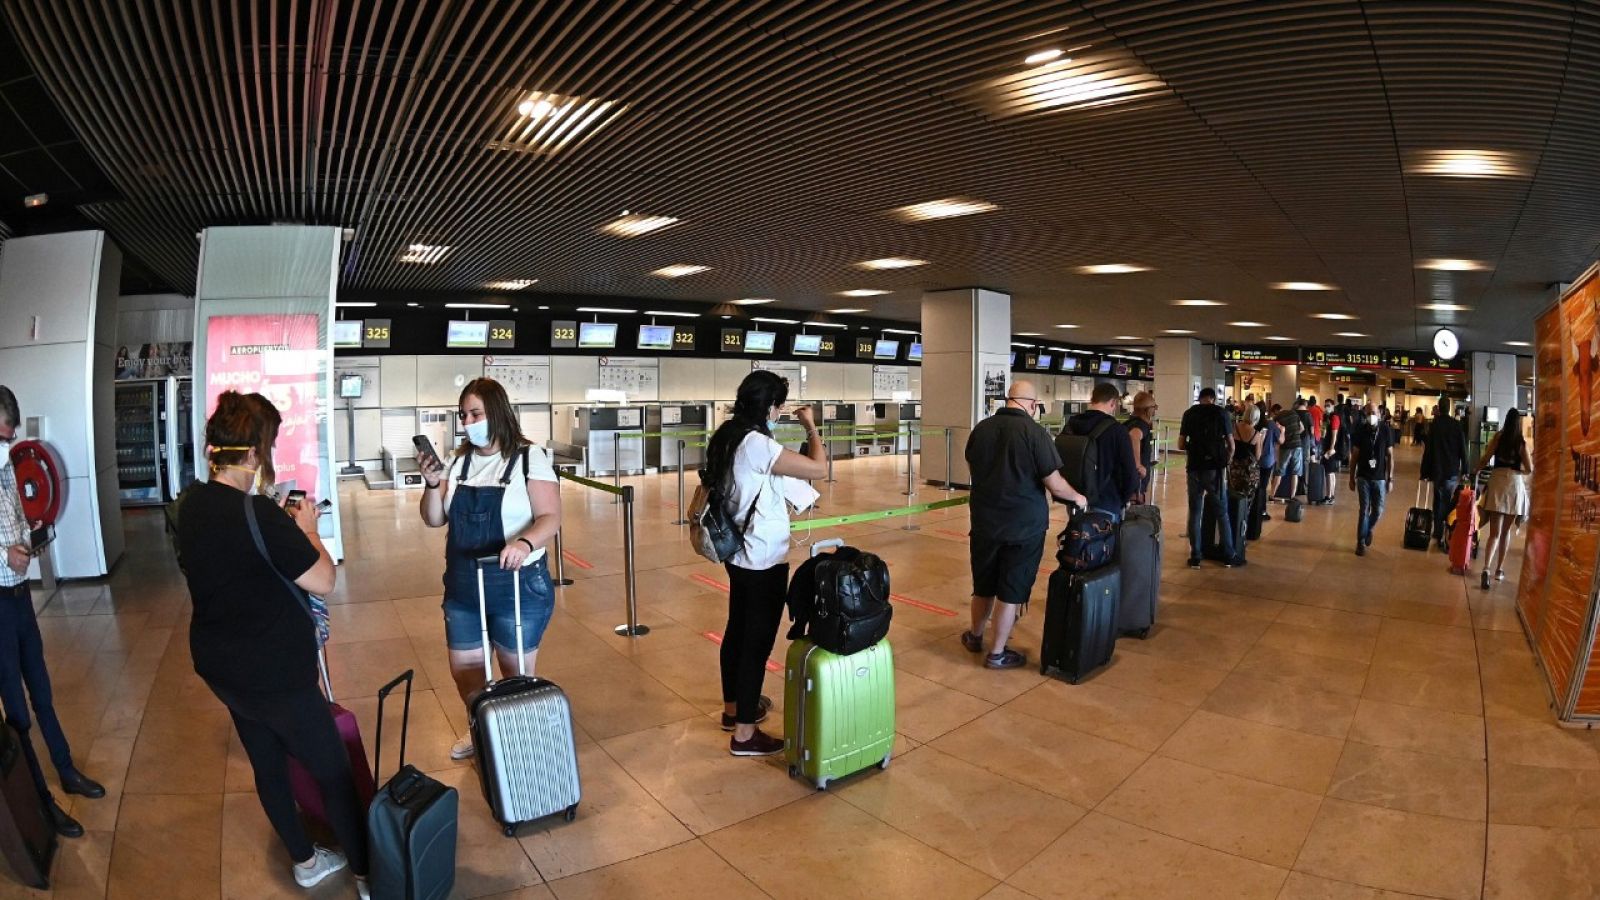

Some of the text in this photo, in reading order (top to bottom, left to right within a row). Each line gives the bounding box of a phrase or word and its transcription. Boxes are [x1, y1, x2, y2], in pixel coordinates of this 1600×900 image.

[366, 328, 389, 339] 325
[491, 329, 513, 340] 324
[554, 329, 575, 340] 323
[675, 333, 693, 343] 322
[724, 334, 741, 345] 321
[859, 343, 873, 353] 319
[118, 354, 192, 368] Enjoy your bre
[210, 371, 261, 386] MUCHO
[275, 463, 296, 473] plus
